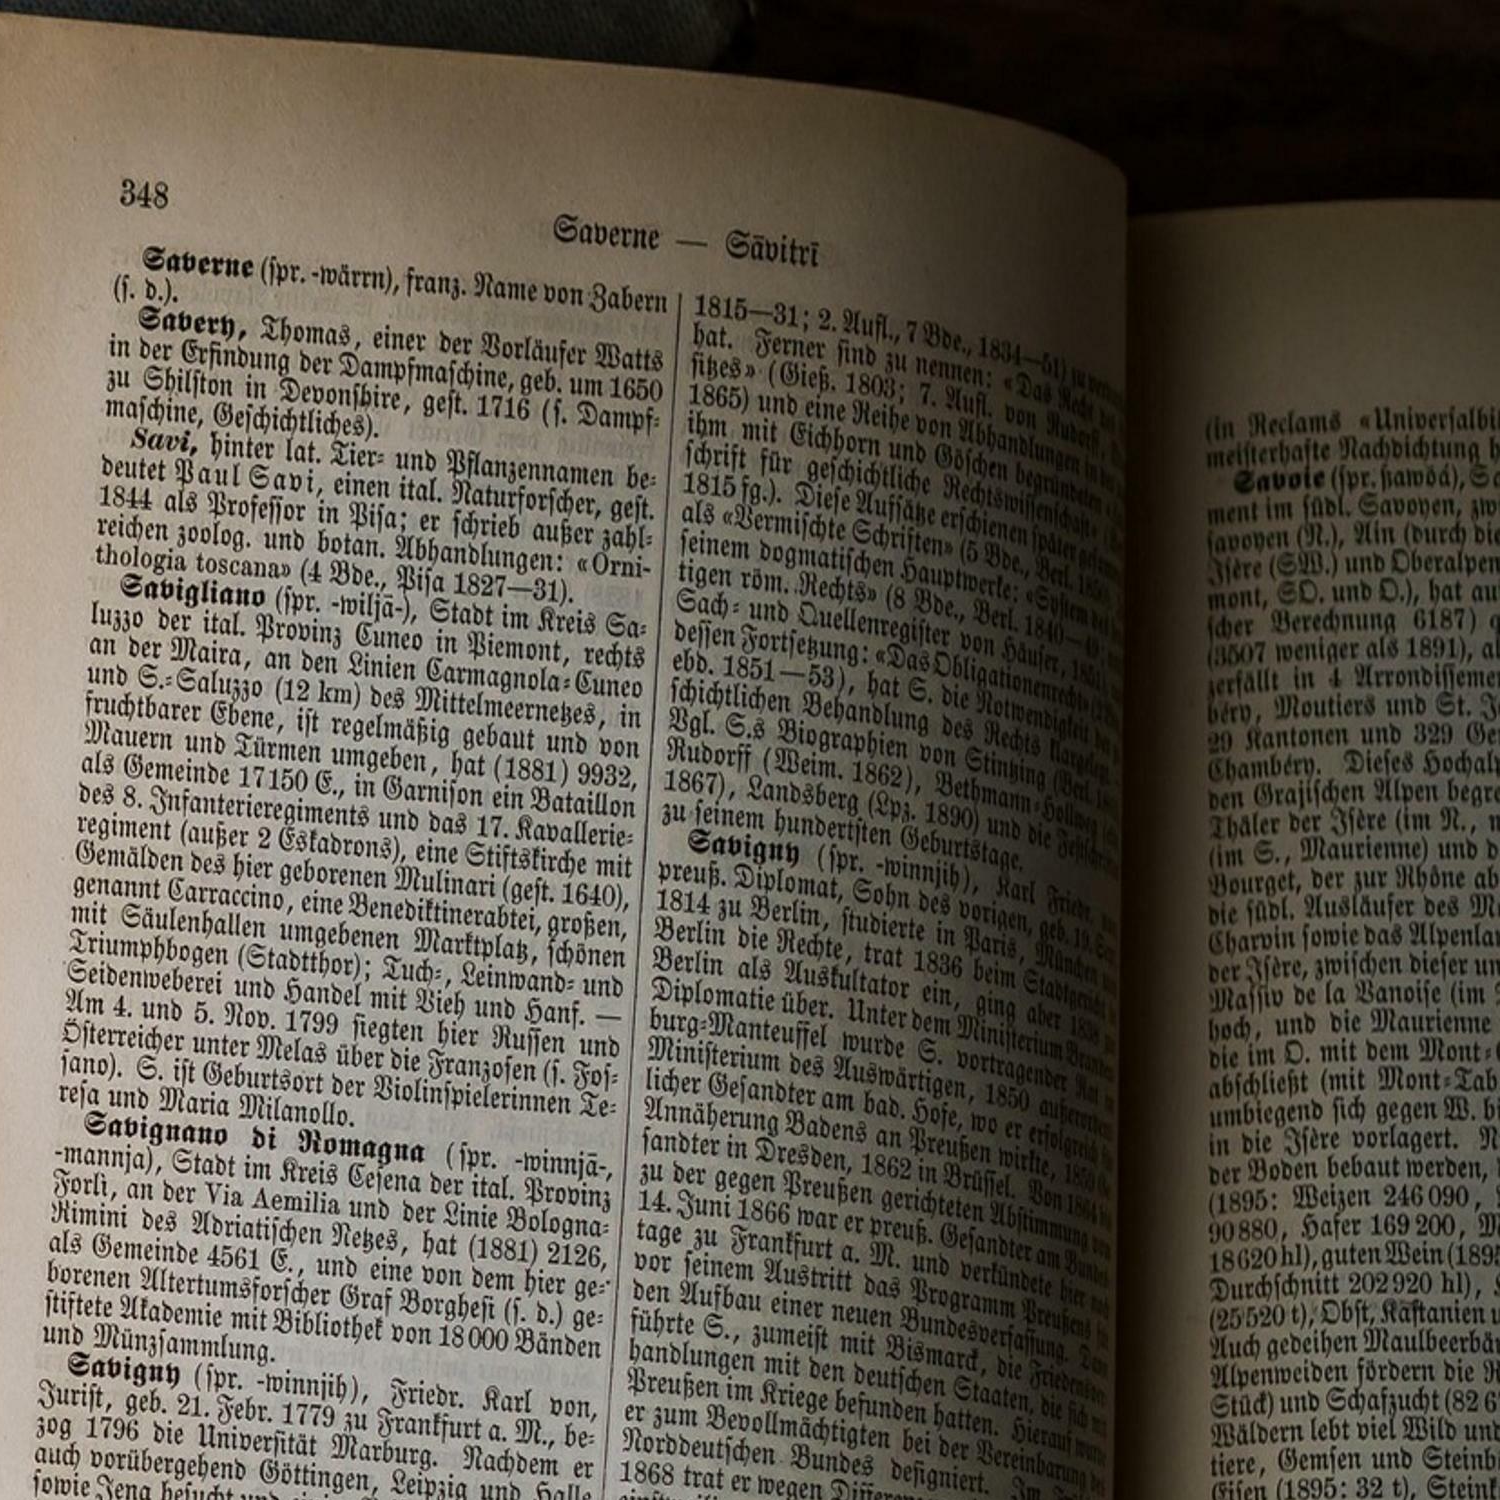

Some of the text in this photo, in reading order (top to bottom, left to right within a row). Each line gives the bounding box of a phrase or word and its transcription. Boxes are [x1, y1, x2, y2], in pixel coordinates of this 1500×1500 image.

[120, 179, 168, 209] 348
[553, 214, 660, 250] Saverne
[142, 246, 254, 278] Saverne
[406, 267, 466, 300] franz.
[474, 272, 537, 300] Name
[590, 283, 668, 313] Zabern
[261, 314, 361, 349] Thomas,
[373, 325, 427, 353] einer
[481, 332, 587, 370] Vorläufer
[596, 342, 663, 372] Watts
[692, 322, 825, 359] hat. Ferner
[181, 339, 663, 402] Erfindung 1650
[689, 385, 846, 422] 1865) eine
[130, 427, 614, 488] Savi, hinter Pflanzennamen
[100, 485, 152, 510] 1844
[102, 456, 442, 502] deutet Paul Savi, ital.
[1234, 467, 1324, 494] Savoie
[96, 544, 186, 574] thologia
[97, 514, 562, 575] reichen zoolog. botan. Abhandlungen:
[120, 573, 596, 634] Savigliano Stadt Kreis
[91, 600, 342, 650] luzzo ital. Provinz
[76, 839, 273, 882] Gemälden hier
[688, 828, 800, 868] Savigny
[73, 876, 294, 916] genannt Carraccino,
[734, 864, 843, 904] Diplomat,
[852, 878, 910, 910] Sohn
[656, 890, 829, 932] 1814 Berlin,
[70, 928, 228, 968] Triumphbogen
[654, 916, 903, 968] Berlin Rechte, trat
[68, 958, 361, 1005] Seidenweberei Handel
[159, 1087, 354, 1128] Maria Milanollo.
[84, 1110, 426, 1165] Savignano di Romagna
[205, 1183, 498, 1228] Via Aemilia Linie
[51, 1200, 607, 1271] Rimini (1881) 2126,
[92, 1233, 260, 1270] Gemeinde 4561
[120, 1294, 601, 1359] Akademie Bänden
[68, 1352, 180, 1389] Savigny
[86, 1416, 139, 1440] 1796
[178, 1394, 335, 1428] 21. Febr. 1779
[1311, 1417, 1350, 1441] lebt
[1357, 1418, 1396, 1441] viel
[620, 1461, 674, 1486] 1868
[684, 1466, 724, 1490] trat
